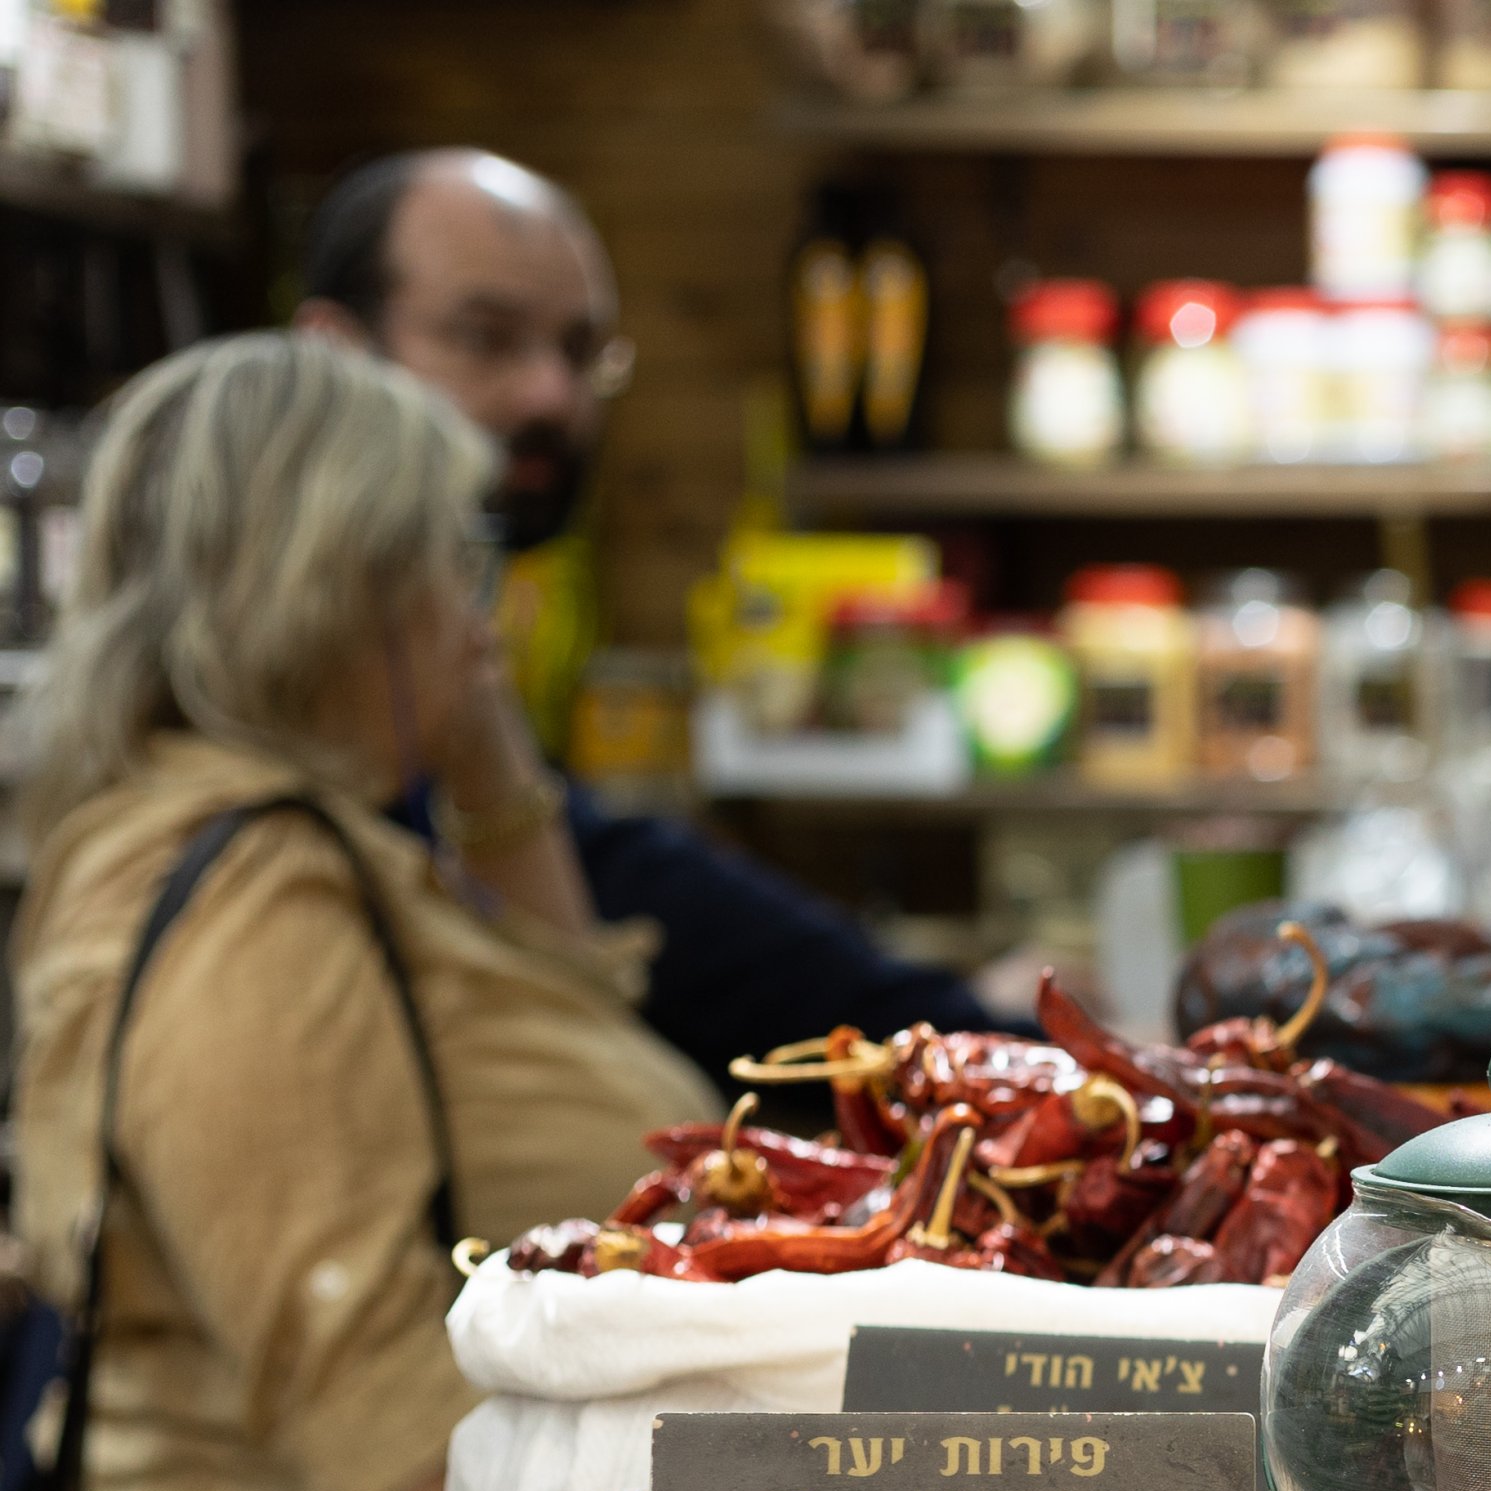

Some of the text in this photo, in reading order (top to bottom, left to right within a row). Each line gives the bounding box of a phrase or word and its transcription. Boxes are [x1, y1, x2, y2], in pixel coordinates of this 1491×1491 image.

[1004, 1351, 1206, 1394] צ'אי הודי
[807, 1435, 1111, 1478] פירות יער
